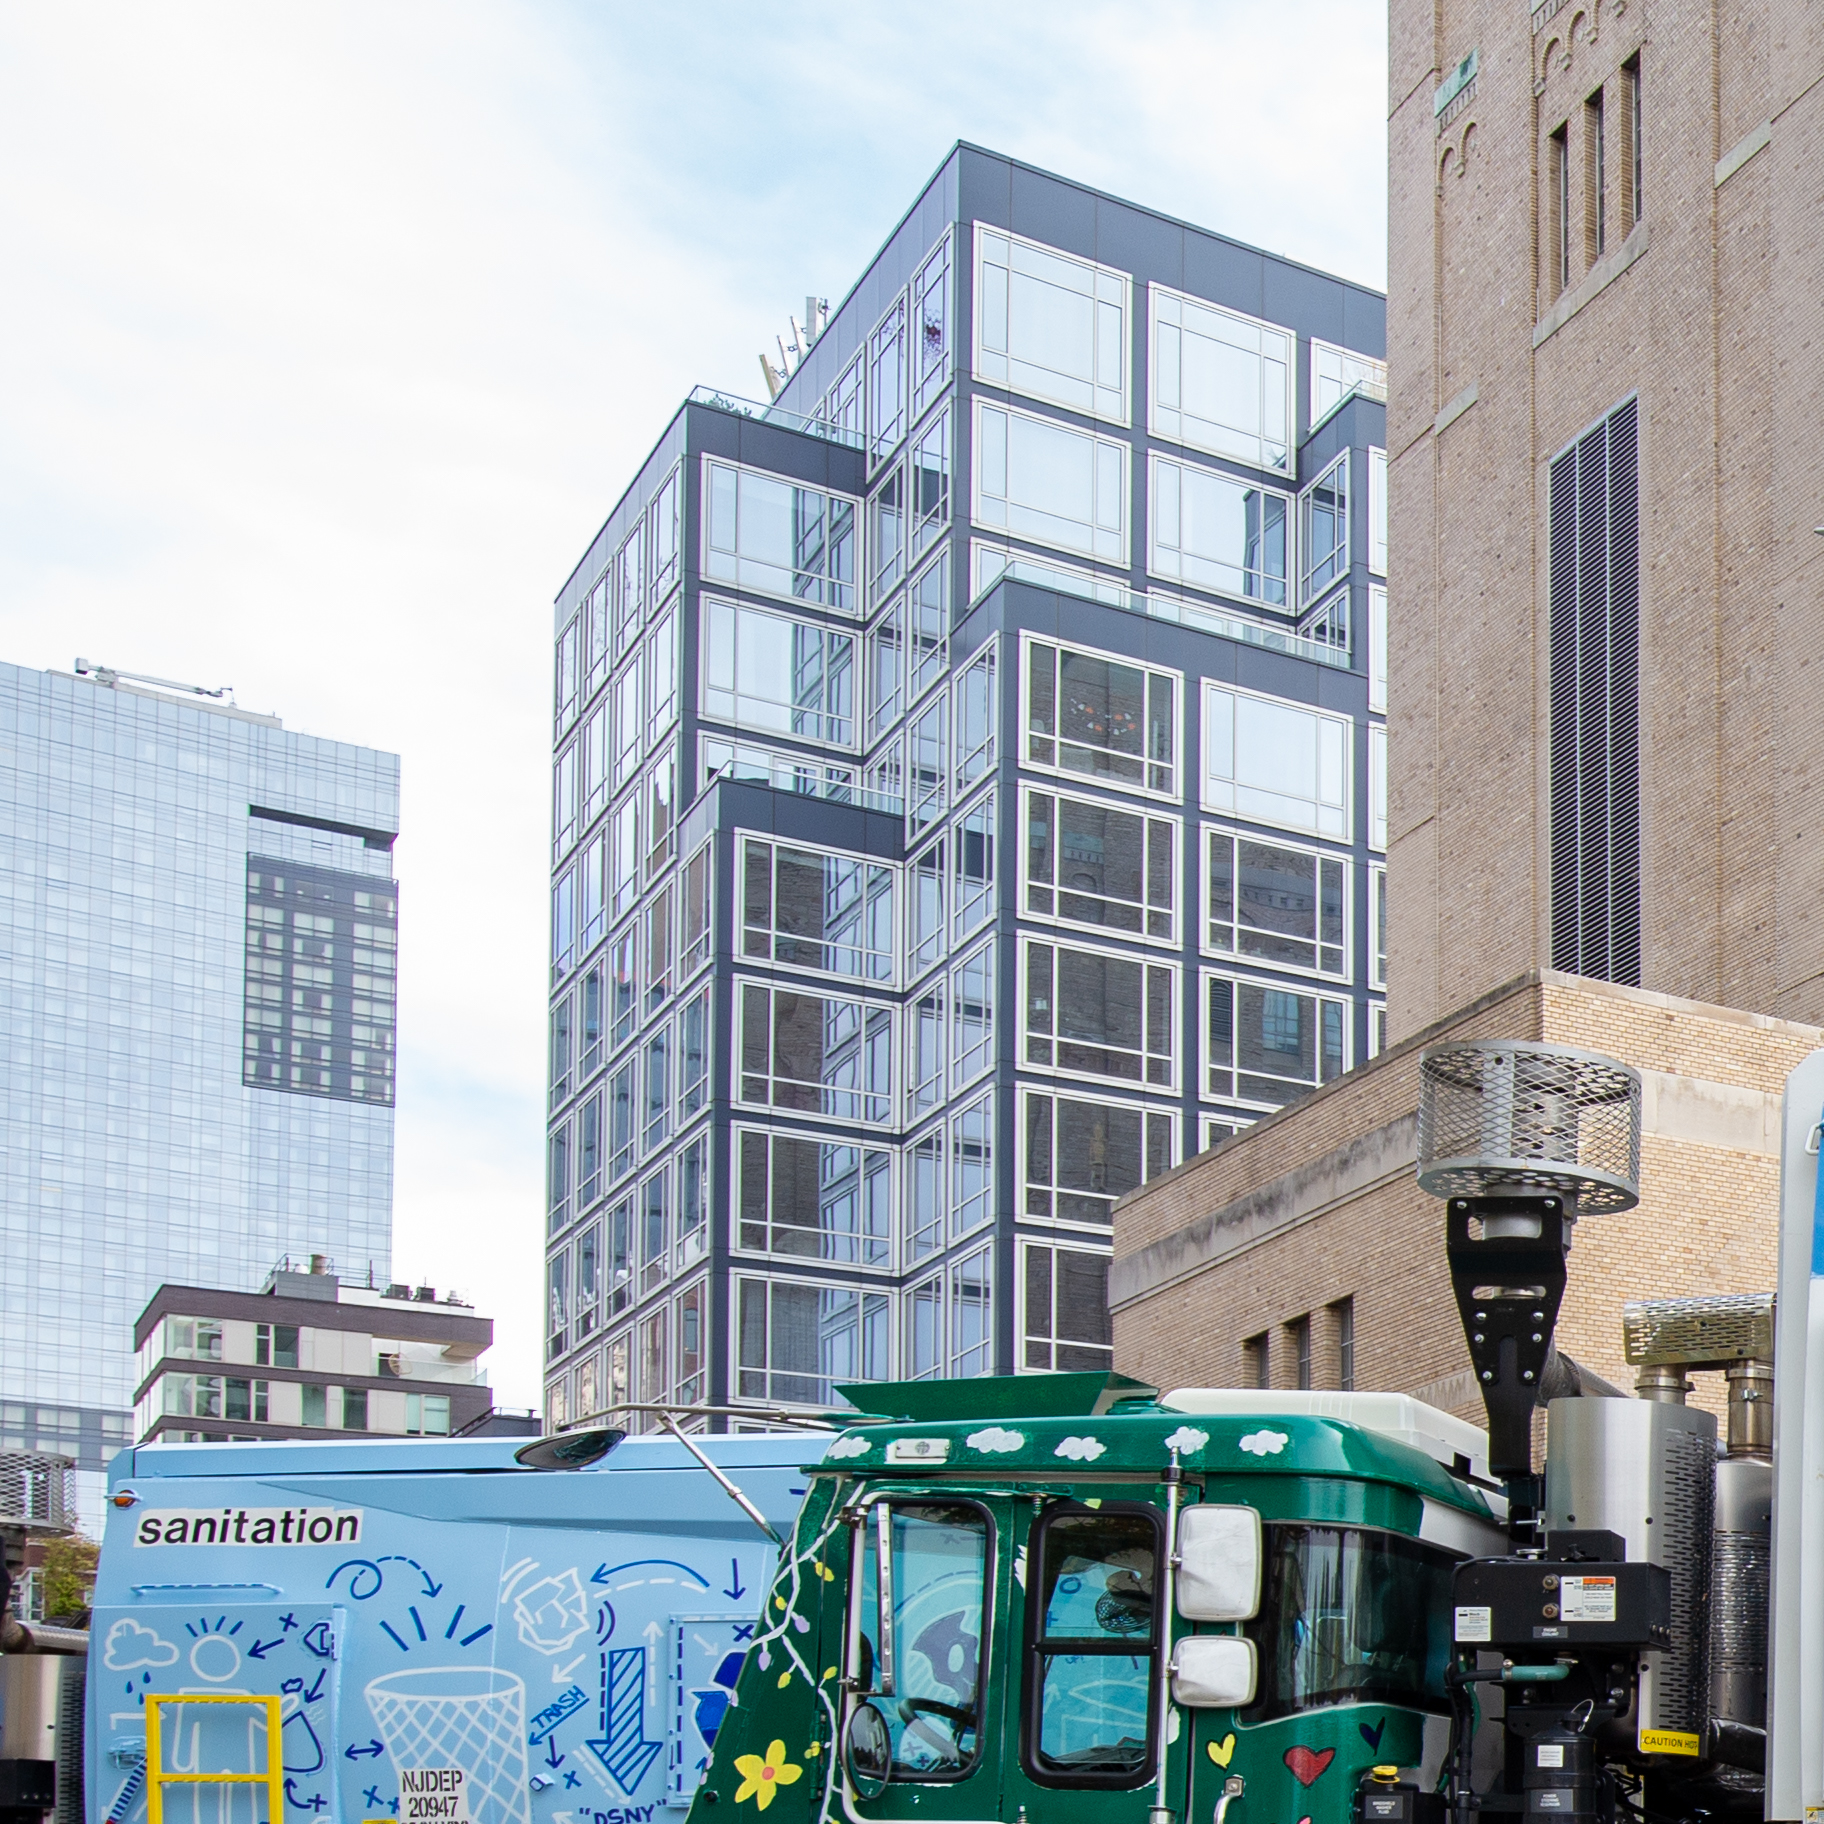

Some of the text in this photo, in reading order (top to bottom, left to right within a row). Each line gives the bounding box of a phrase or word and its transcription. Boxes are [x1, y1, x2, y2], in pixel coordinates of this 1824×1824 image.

[138, 1508, 359, 1544] sanitation
[530, 1684, 587, 1729] TRASH
[1643, 1735, 1683, 1748] CAUTION
[402, 1770, 463, 1793] NJDEP
[408, 1796, 459, 1818] 20947
